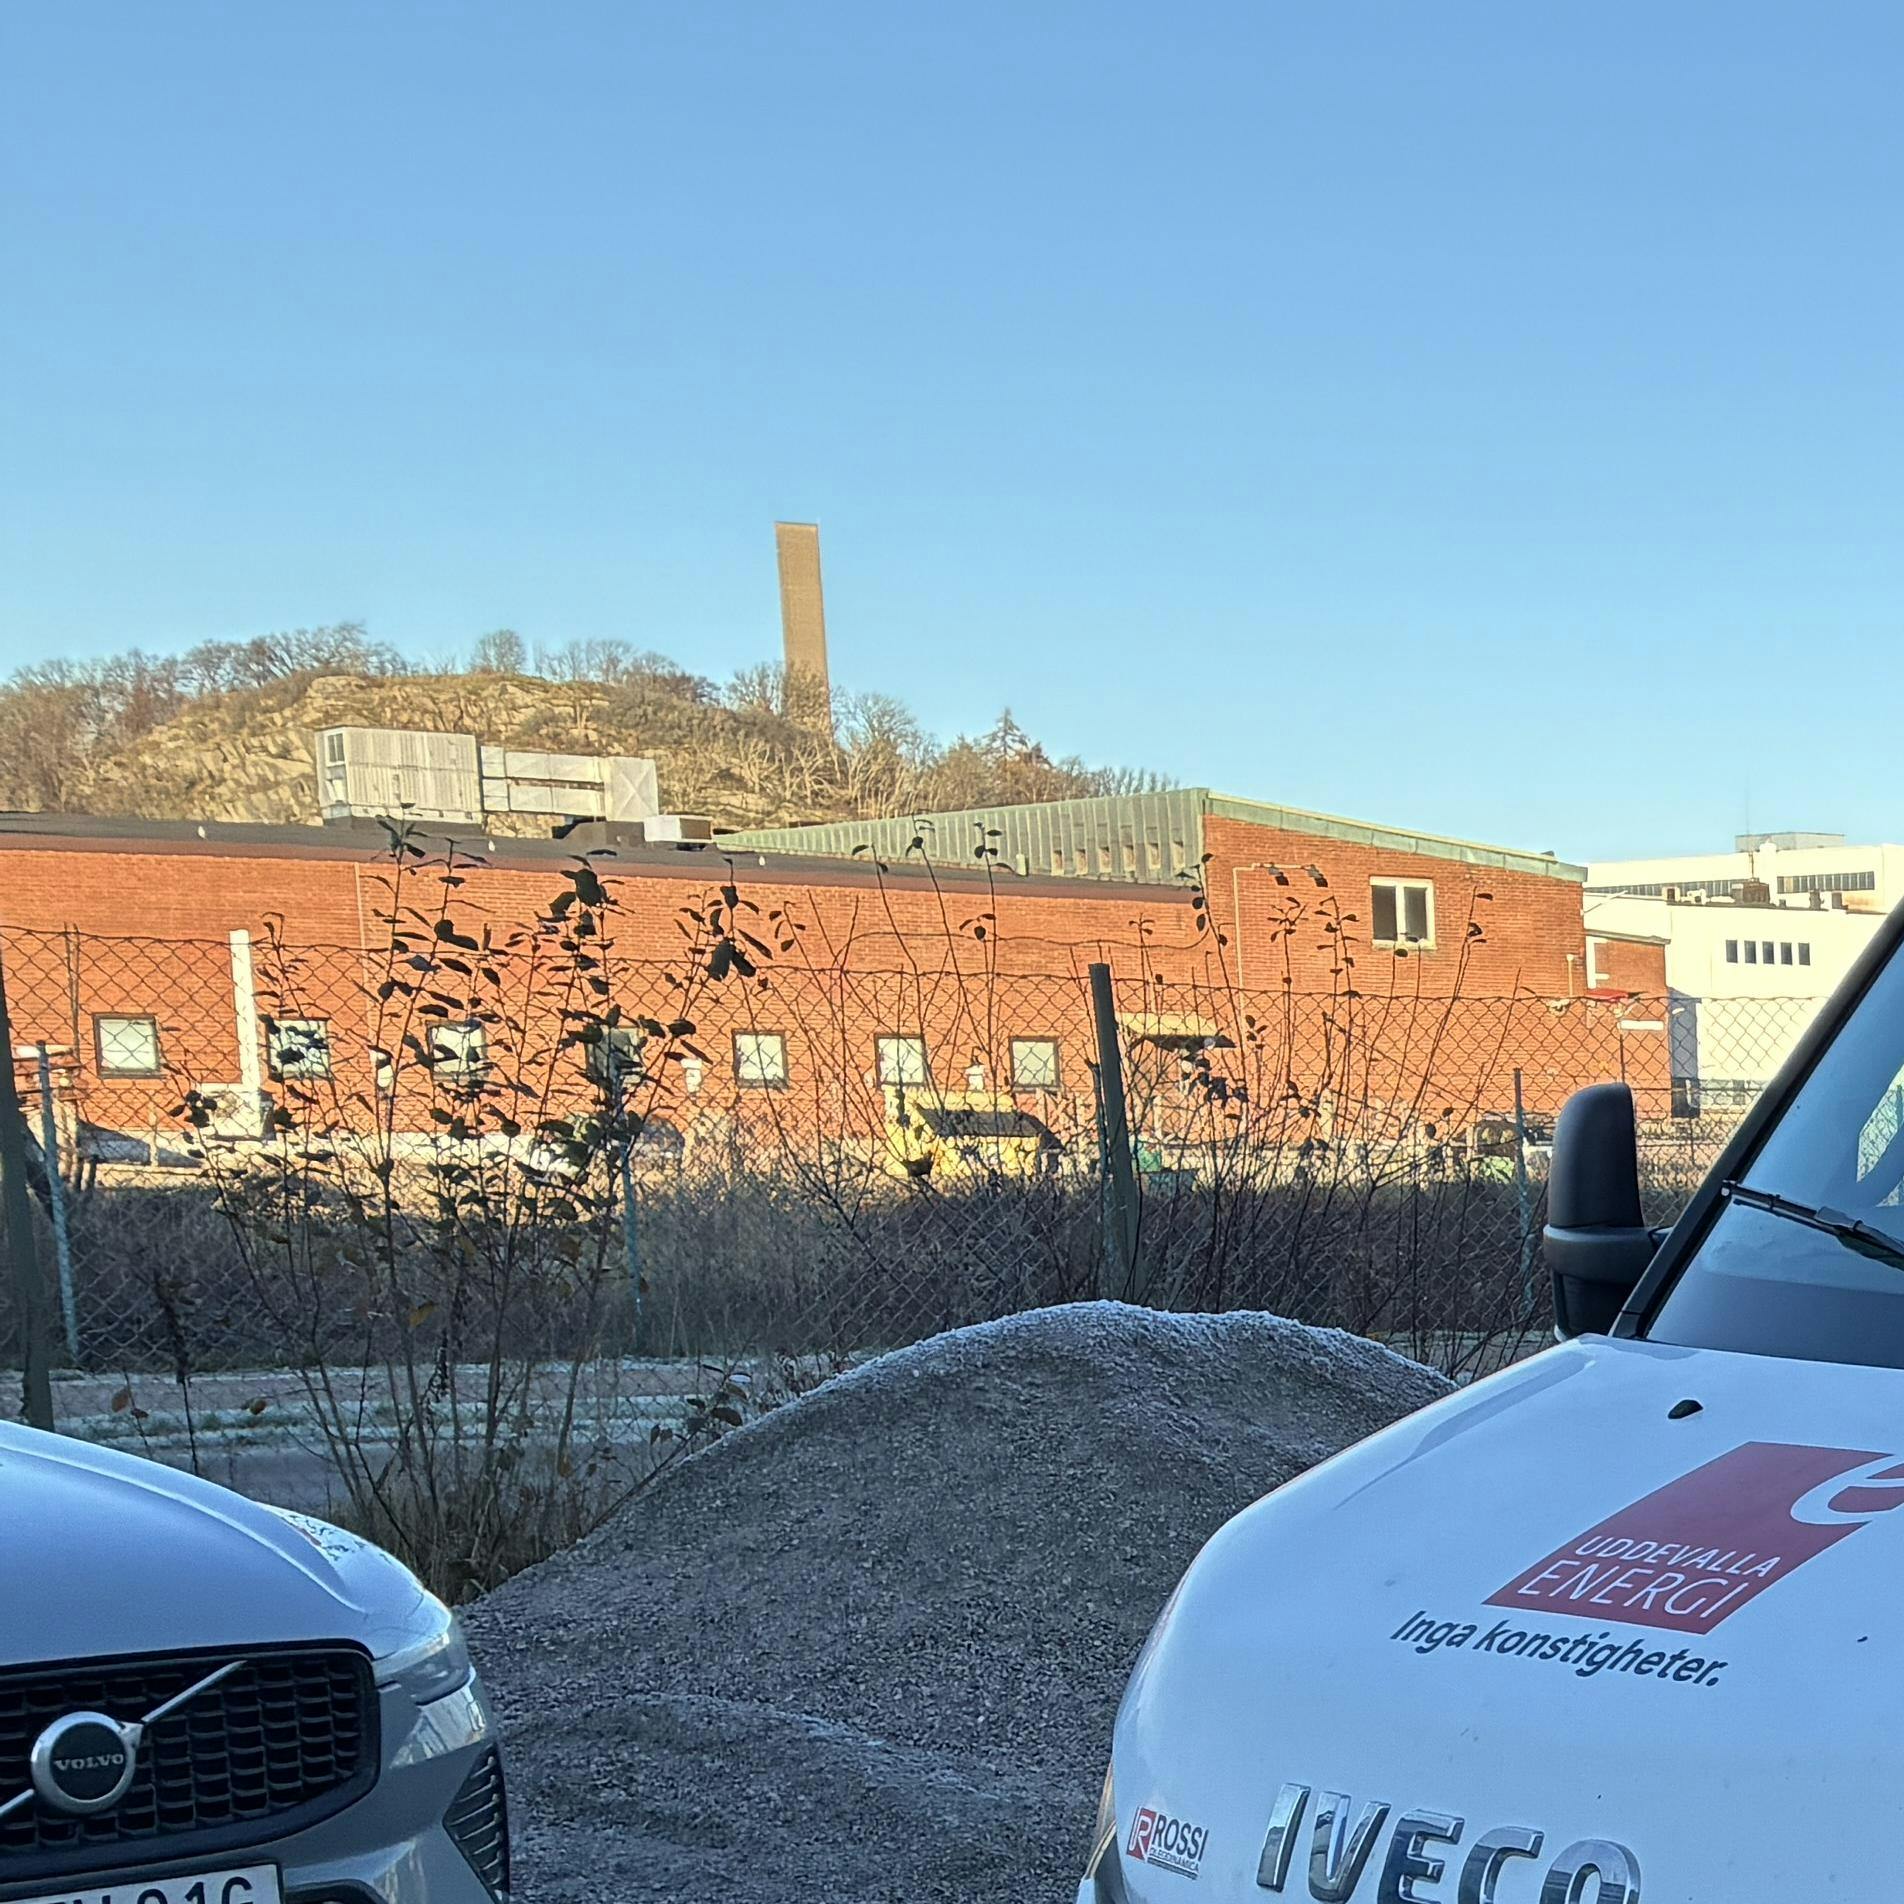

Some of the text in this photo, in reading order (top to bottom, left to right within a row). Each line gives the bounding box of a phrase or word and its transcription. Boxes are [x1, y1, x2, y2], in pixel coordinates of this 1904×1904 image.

[1574, 1534, 1782, 1577] UDDEVALLA
[1516, 1559, 1747, 1620] ENERGI
[1389, 1610, 1728, 1687] Inga konstigheter.
[54, 1754, 124, 1771] VOLVO
[1152, 1814, 1209, 1863] ROSSI
